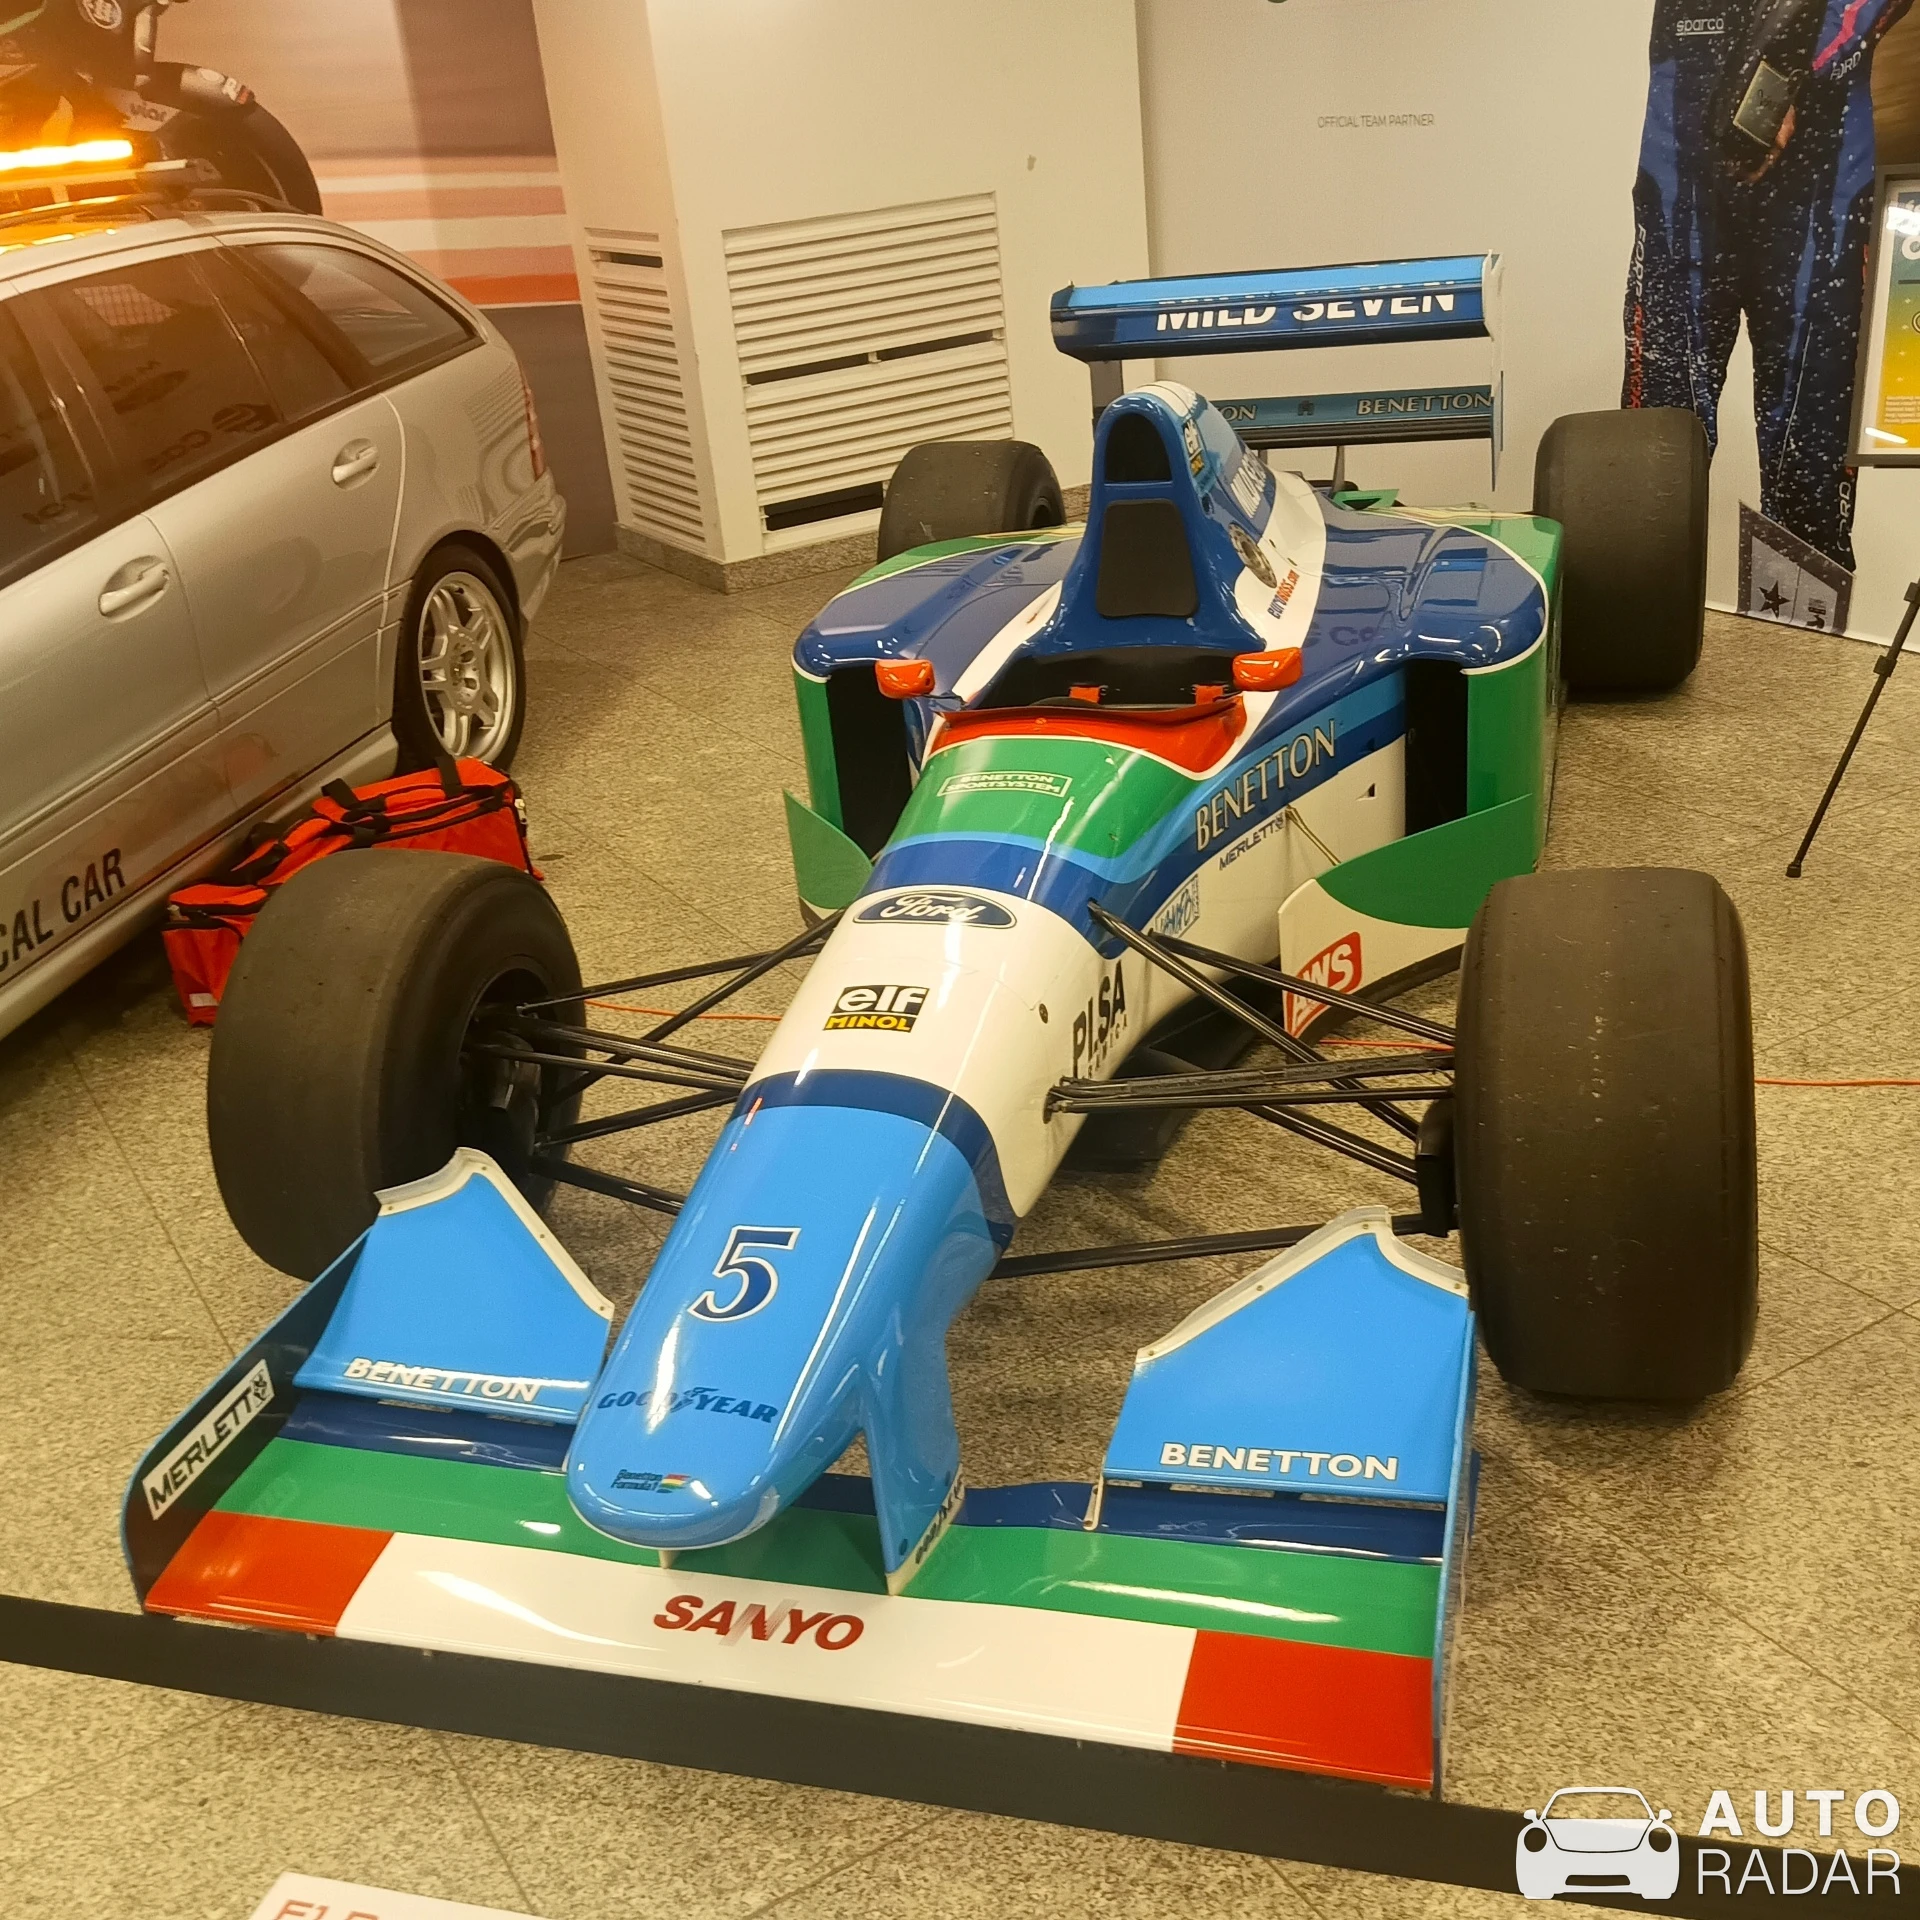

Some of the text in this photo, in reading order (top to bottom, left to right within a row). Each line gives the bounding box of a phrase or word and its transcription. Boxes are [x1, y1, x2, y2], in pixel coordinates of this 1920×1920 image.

[1676, 17, 1725, 34] sparco
[1317, 113, 1435, 128] OFFICIAL TEAM PARTNER
[1356, 393, 1493, 416] BENETTON
[945, 780, 1062, 793] SPORTSYSTEM
[960, 773, 1055, 783] BENETTON
[1195, 718, 1337, 852] BENETTON
[61, 847, 126, 924] CAR
[879, 893, 987, 922] Ford
[837, 986, 930, 1014] elf
[825, 1015, 912, 1032] MINOL
[1073, 959, 1126, 1079] PISA
[687, 1224, 802, 1322] 5
[343, 1357, 543, 1402] BENETTON
[1159, 1442, 1399, 1481] BENETTON
[653, 1594, 865, 1651] SANYO
